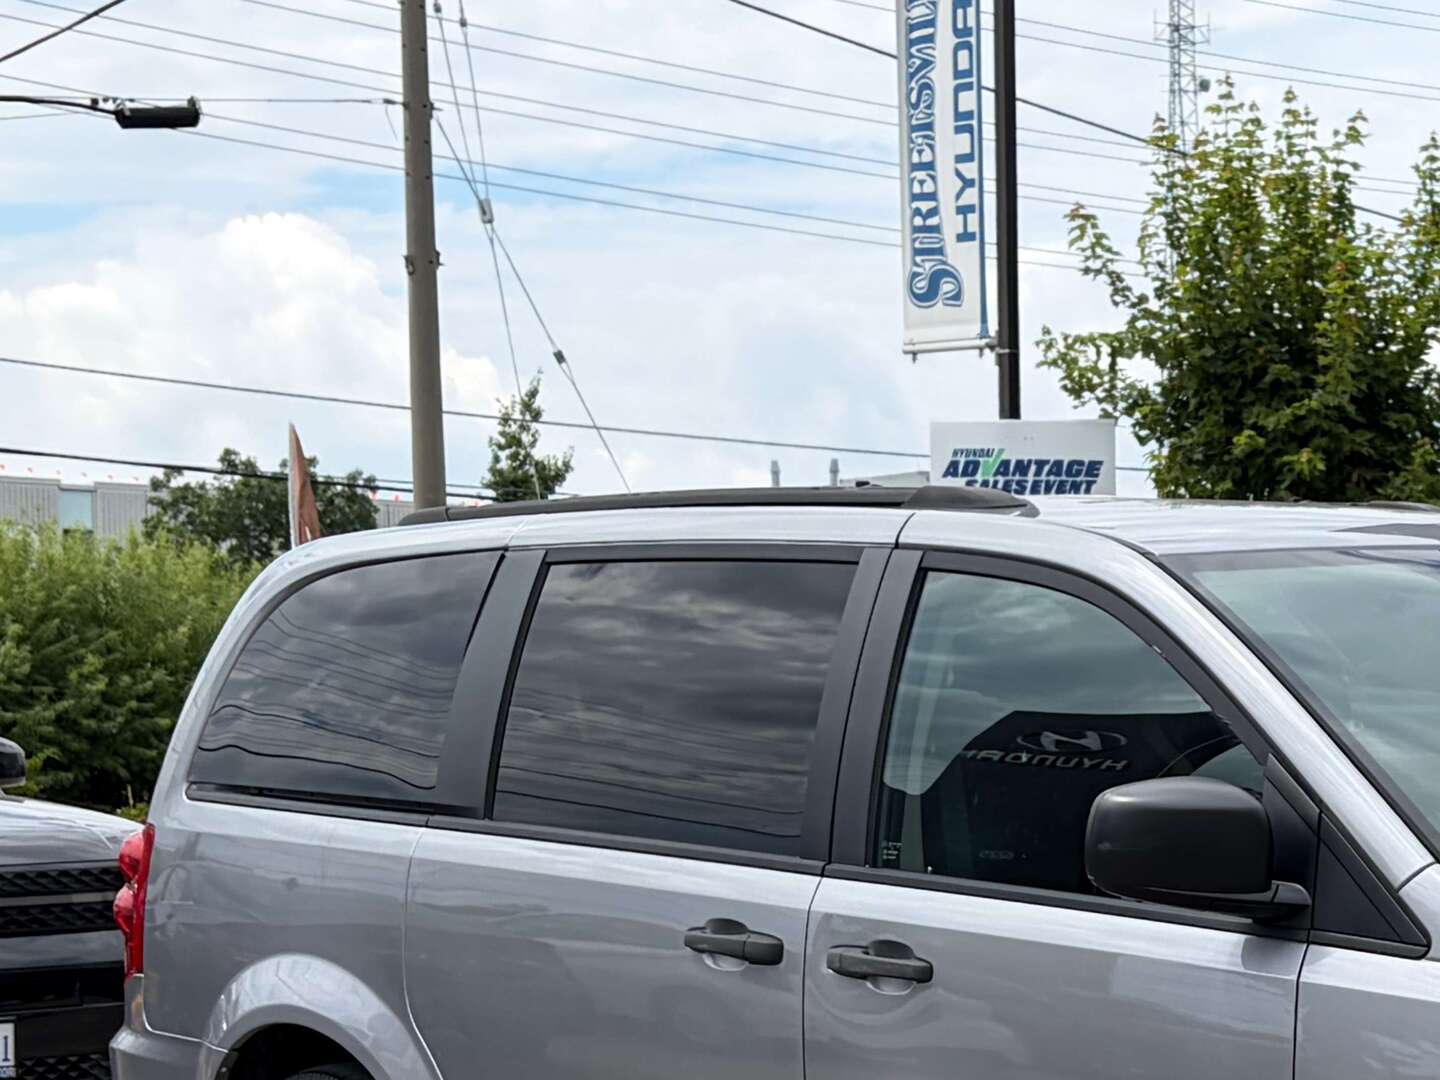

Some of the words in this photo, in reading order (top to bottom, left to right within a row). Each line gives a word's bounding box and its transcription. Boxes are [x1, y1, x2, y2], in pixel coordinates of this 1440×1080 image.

[951, 447, 995, 458] HYUNDAI
[942, 456, 1104, 478] ADVANTAGE
[1029, 479, 1097, 495] EVENT
